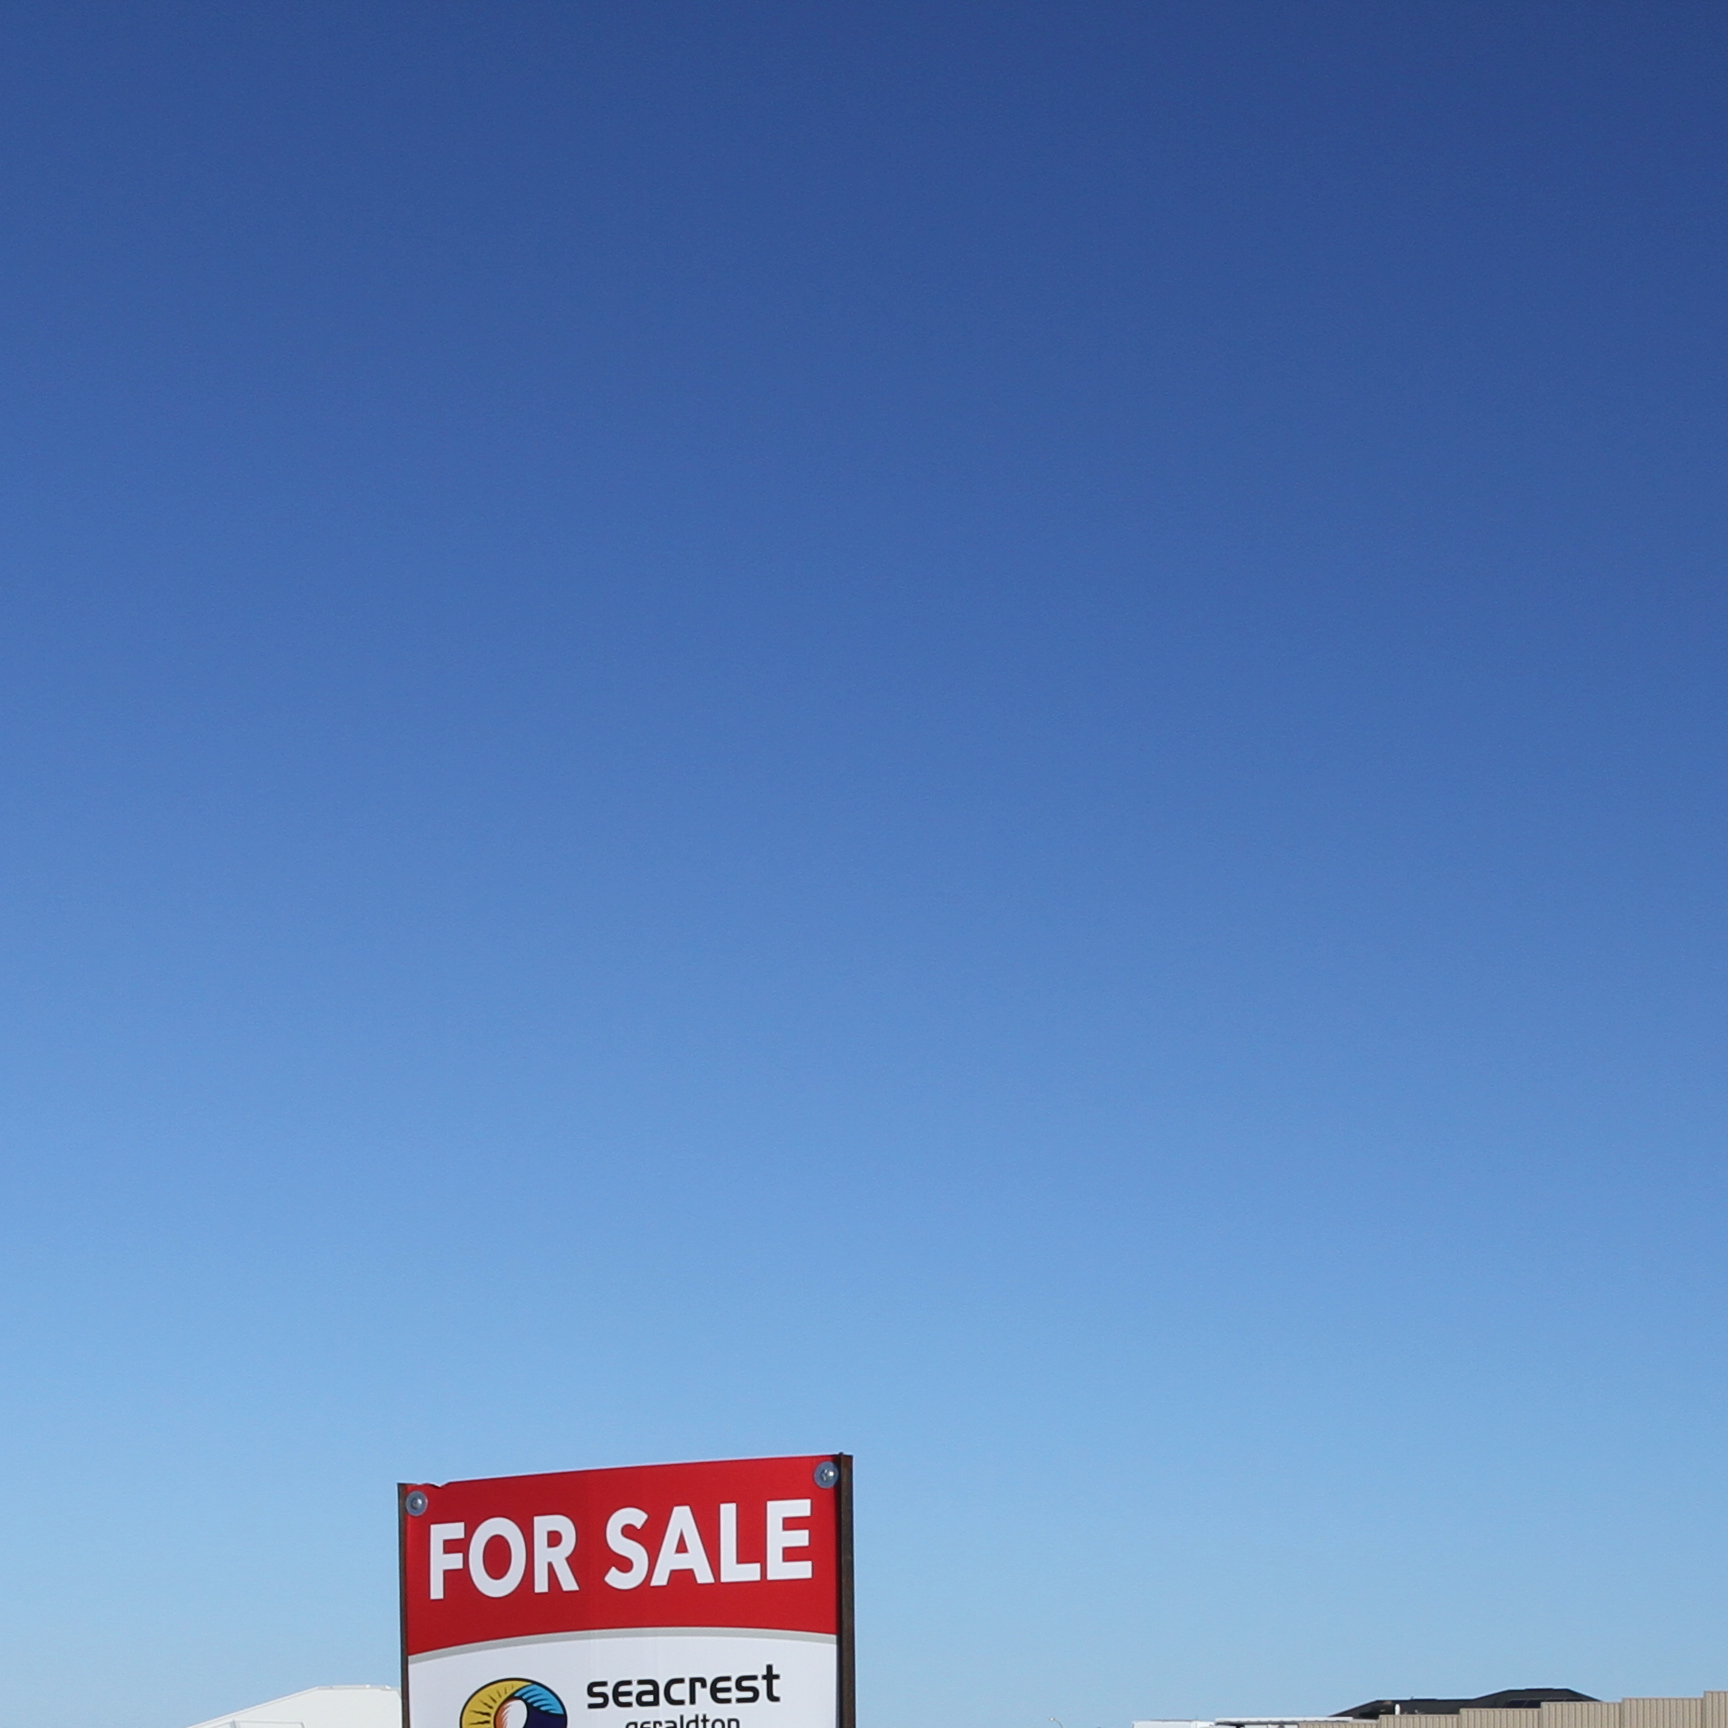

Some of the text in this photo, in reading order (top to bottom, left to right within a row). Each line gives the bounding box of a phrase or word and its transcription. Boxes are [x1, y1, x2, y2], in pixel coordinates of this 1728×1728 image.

[429, 1499, 813, 1600] FOR SALE
[586, 1664, 781, 1709] seacrest
